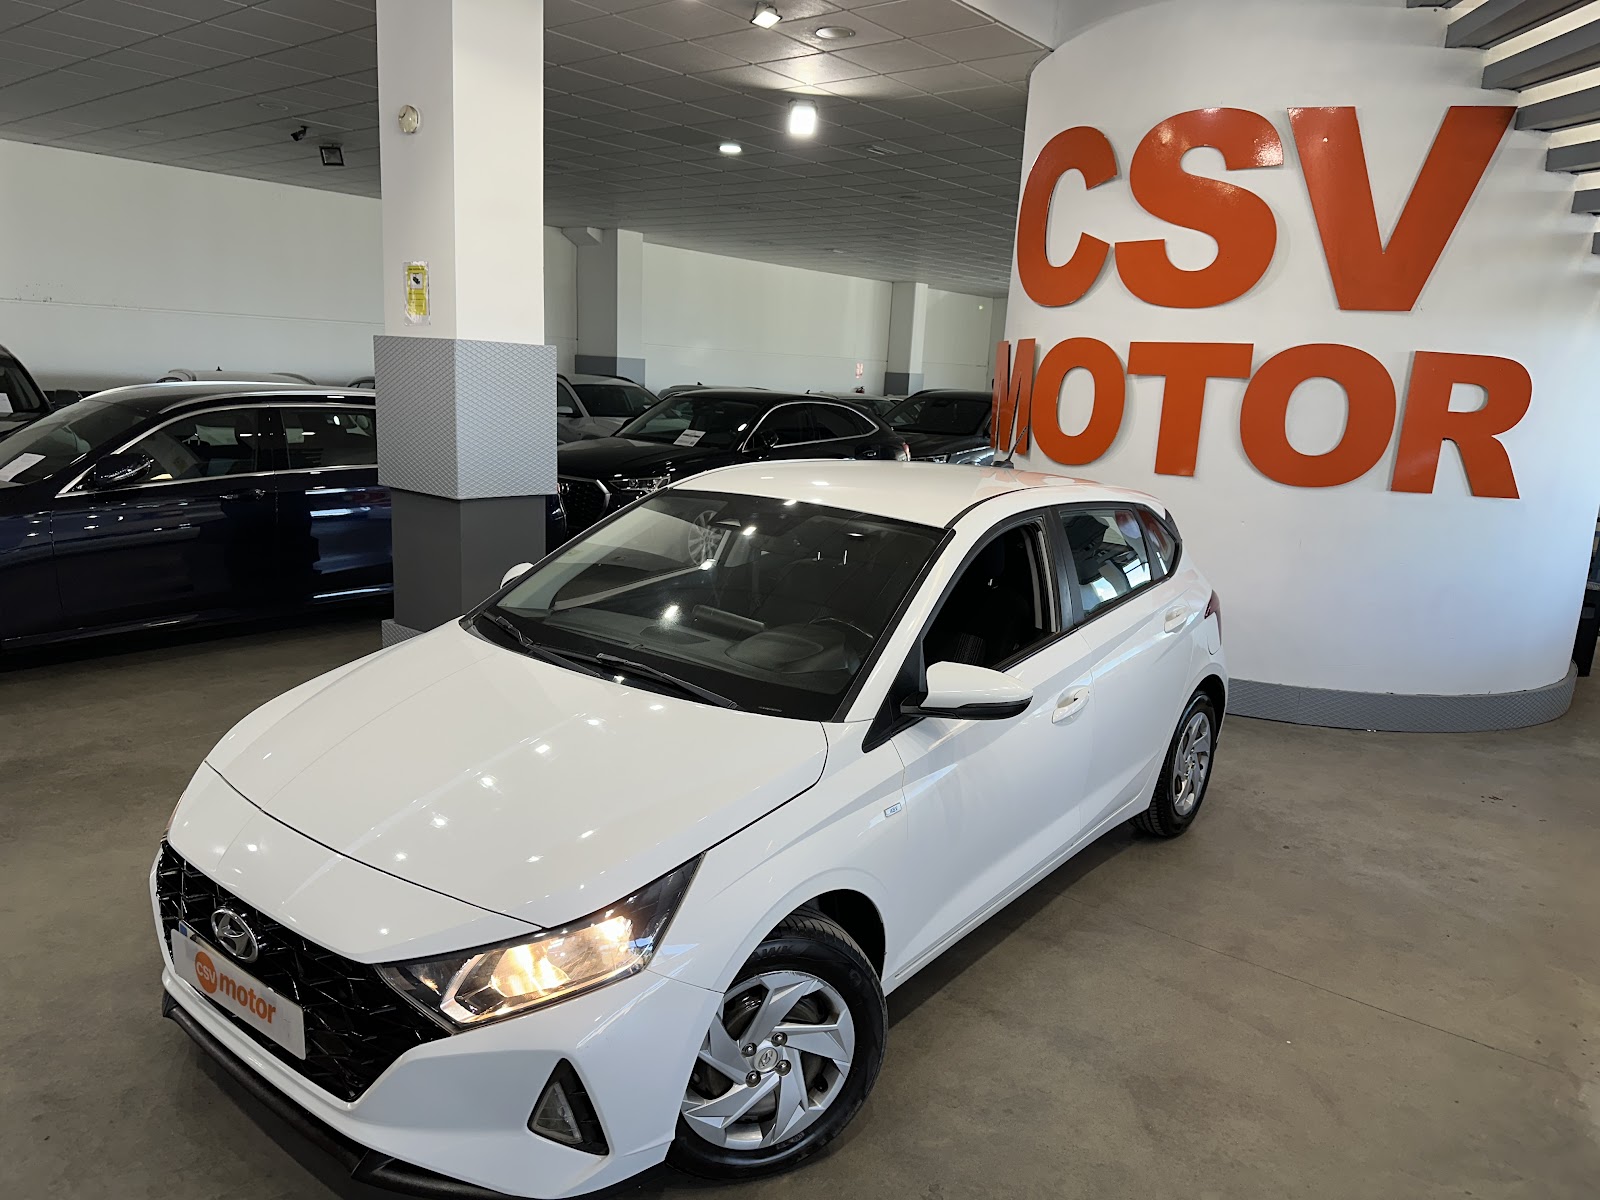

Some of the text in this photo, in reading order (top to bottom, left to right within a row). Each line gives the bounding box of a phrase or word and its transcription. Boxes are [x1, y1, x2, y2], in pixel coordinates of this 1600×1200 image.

[1017, 106, 1518, 312] CSV
[989, 337, 1532, 499] MOTOR
[196, 961, 277, 1024] CSV motor
